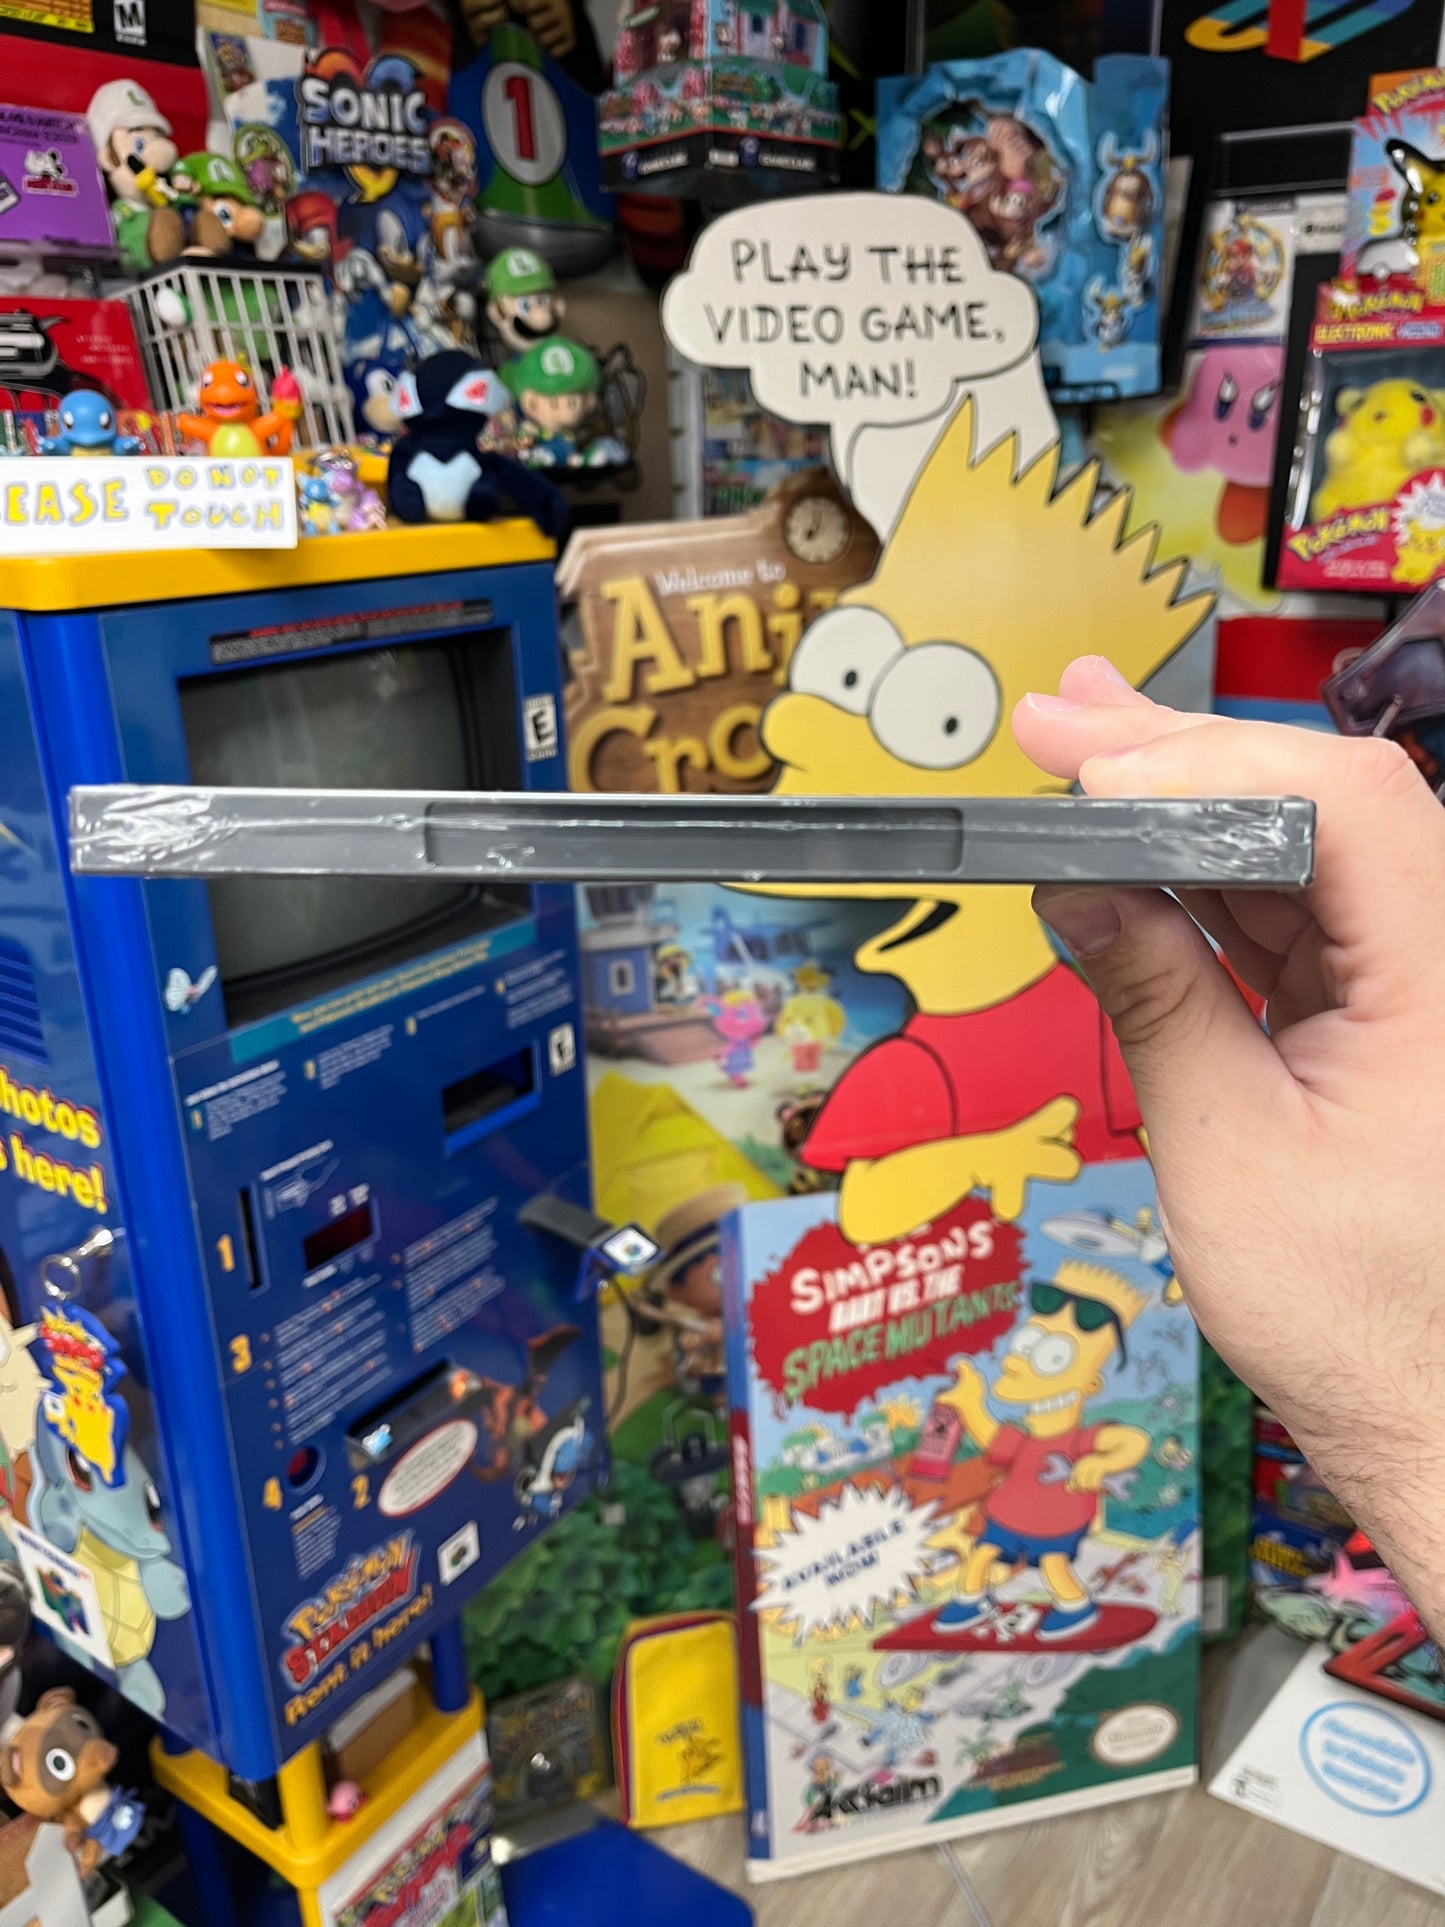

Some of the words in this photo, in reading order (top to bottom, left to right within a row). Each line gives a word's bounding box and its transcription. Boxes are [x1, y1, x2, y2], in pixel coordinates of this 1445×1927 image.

[115, 1, 142, 28] M
[302, 78, 427, 136] SONIC
[505, 76, 536, 161] 1
[305, 124, 432, 174] HEROES
[731, 238, 850, 285] PLAY
[868, 244, 966, 285] THE
[702, 303, 845, 344] VIDEO
[859, 301, 1006, 343] GAME,
[800, 361, 917, 399] MAN!
[146, 466, 198, 490] DO
[208, 464, 285, 491] NOT
[3, 481, 129, 527] EASE
[146, 500, 285, 531] TOUCH
[654, 564, 754, 596] Welcome
[756, 557, 787, 582] to
[601, 572, 838, 702] Ani
[532, 709, 553, 742] E
[567, 703, 777, 793] Cro
[0, 1065, 101, 1149] hotos
[10, 1130, 108, 1214] here!
[217, 1234, 235, 1272] 1
[790, 1220, 995, 1314] SIMPSONS
[229, 1334, 252, 1373] 3
[783, 1322, 883, 1397] SPACE
[885, 1281, 1020, 1360] MUTANTS
[263, 1477, 283, 1510] 4
